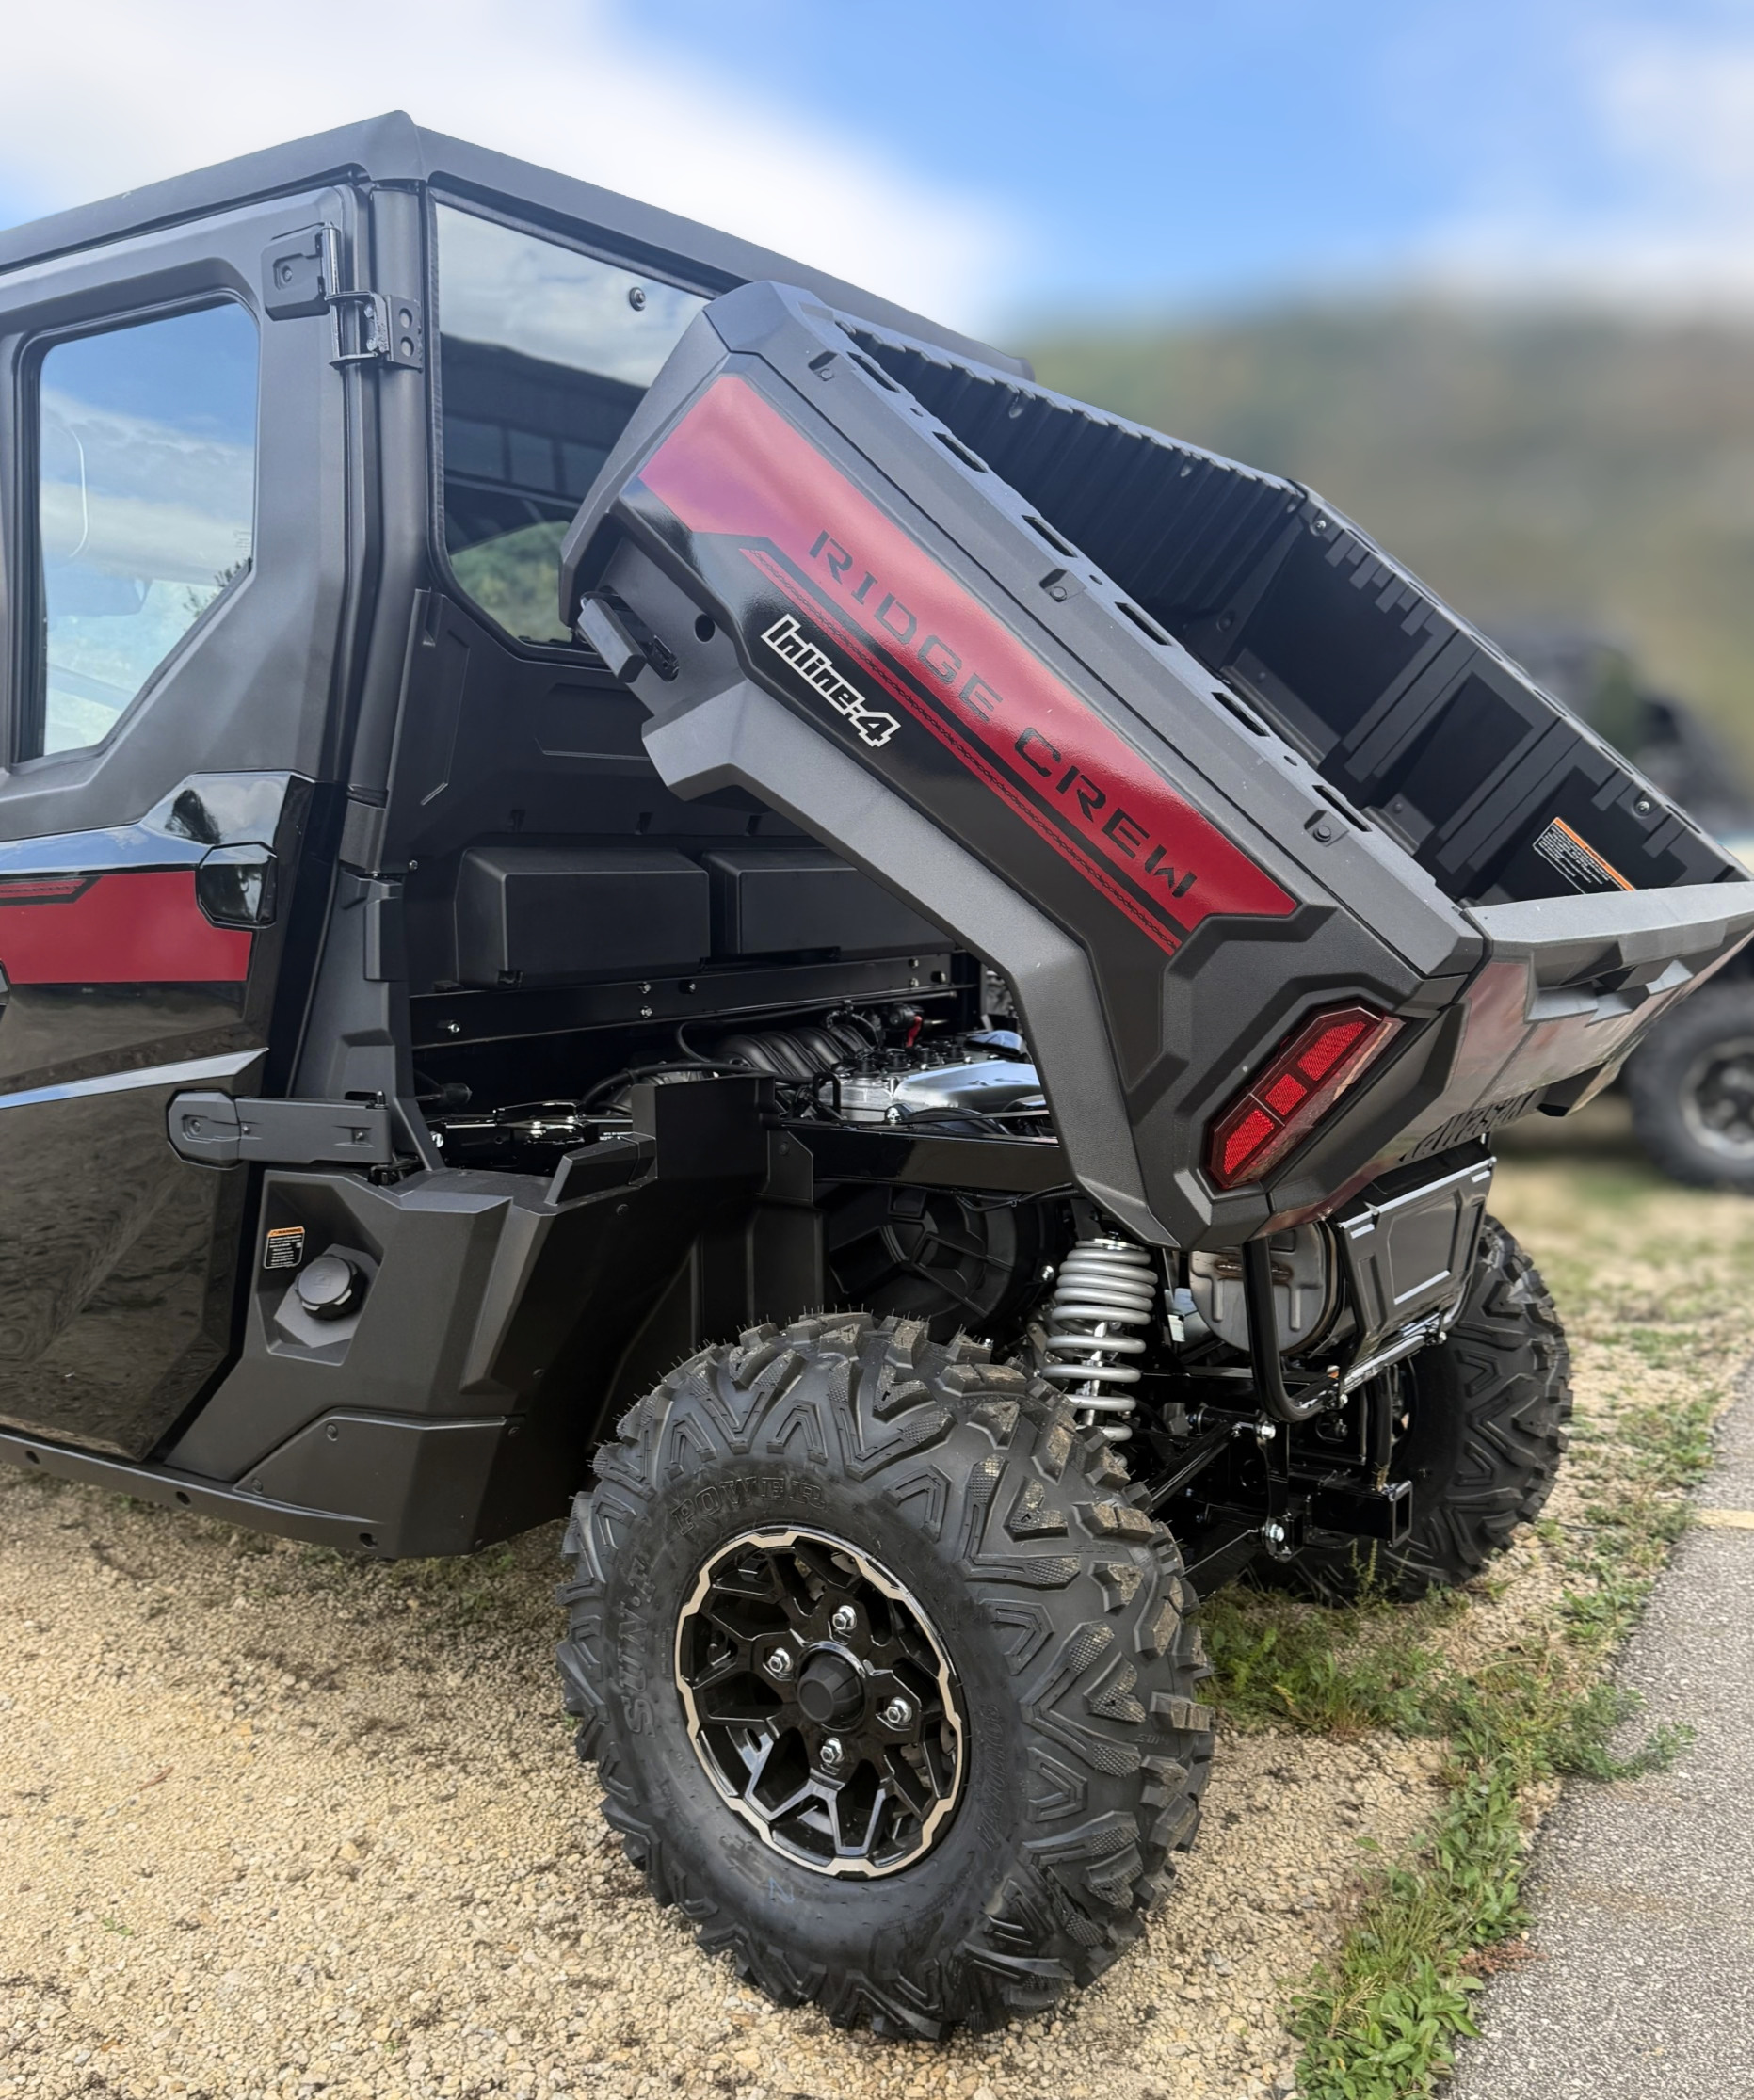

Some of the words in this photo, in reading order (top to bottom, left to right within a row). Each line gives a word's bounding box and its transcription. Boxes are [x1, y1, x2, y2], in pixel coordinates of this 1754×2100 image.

[761, 613, 902, 748] Inline-4
[809, 530, 1004, 723] RIDGE
[1014, 727, 1198, 899] CREW
[670, 1475, 827, 1536] POWER
